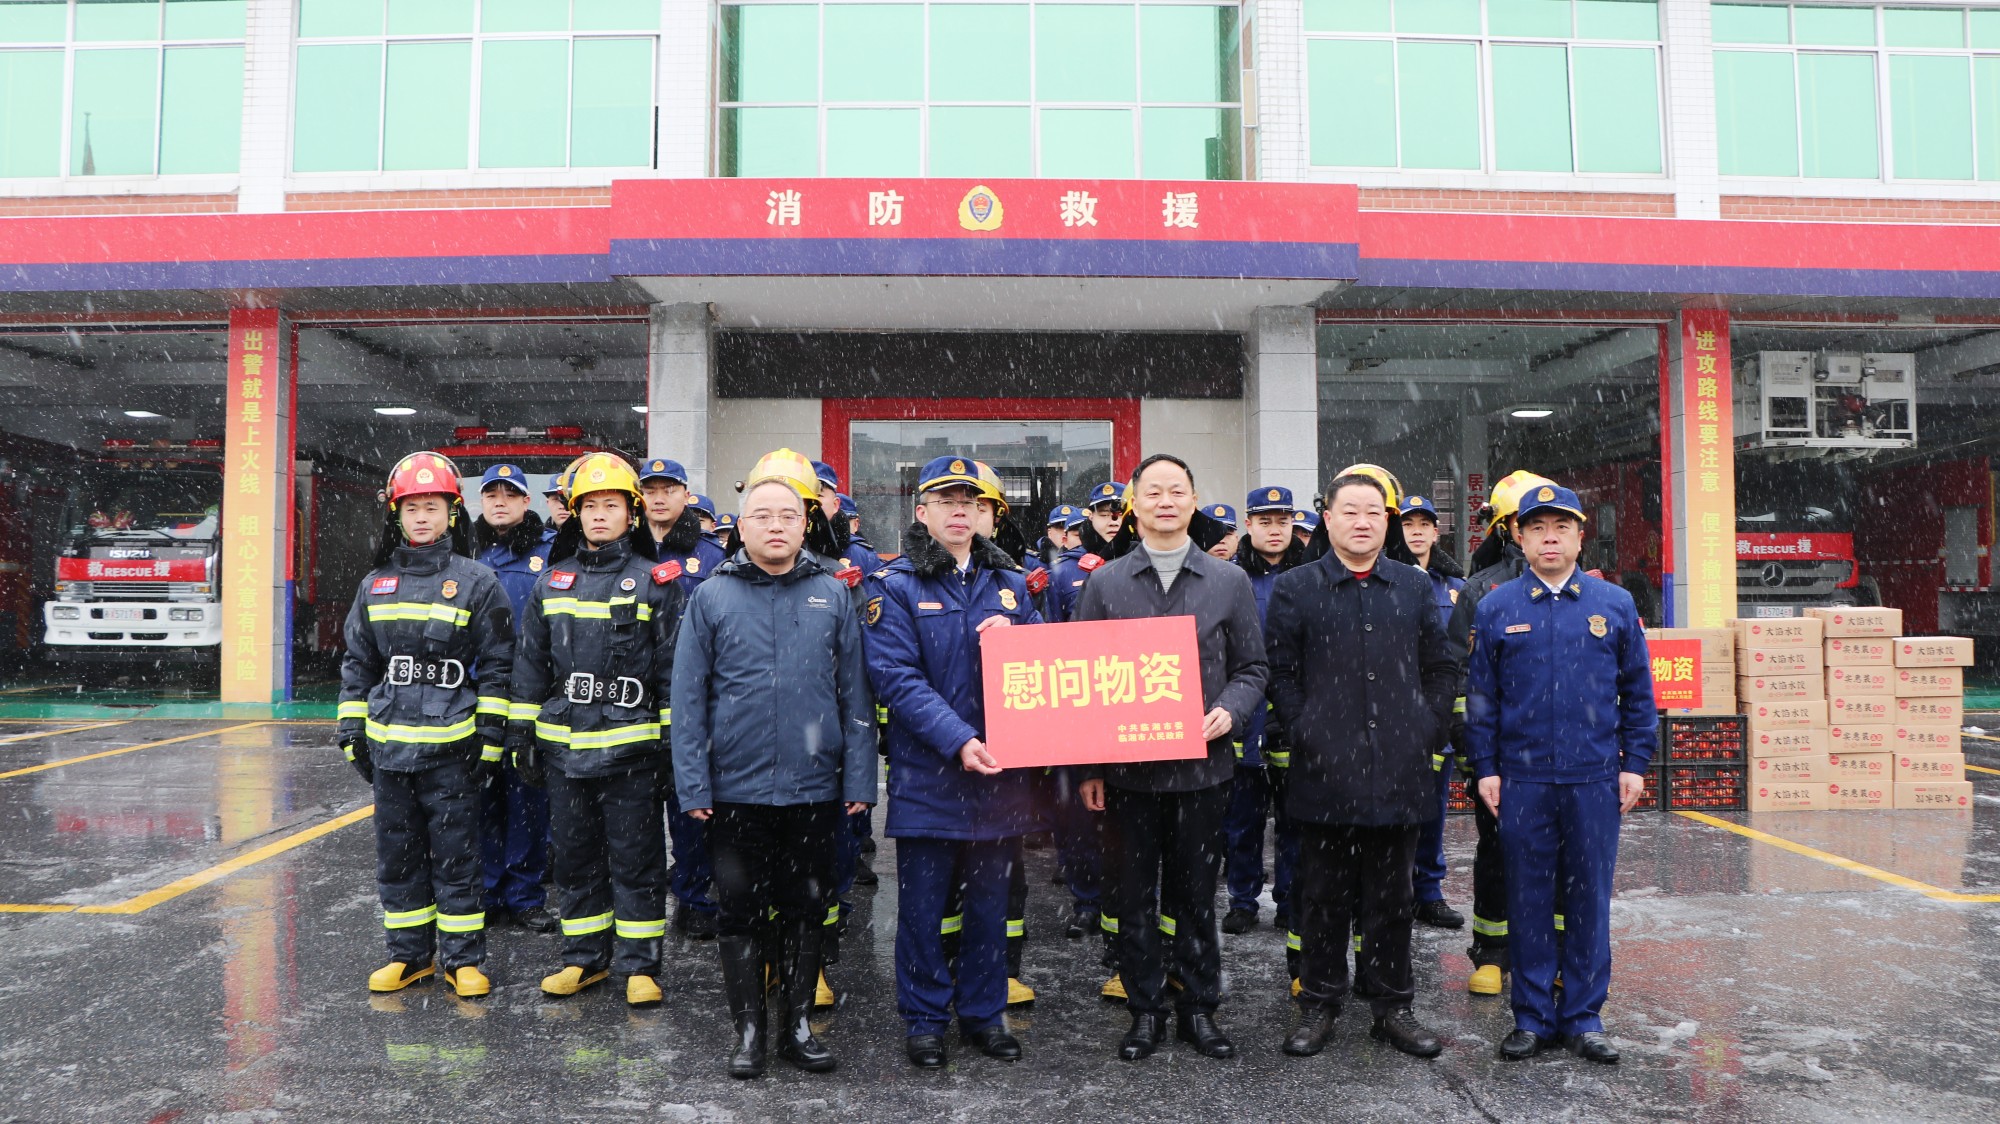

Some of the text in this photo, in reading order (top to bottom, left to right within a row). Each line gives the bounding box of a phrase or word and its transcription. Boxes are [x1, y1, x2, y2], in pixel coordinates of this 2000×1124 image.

[1696, 331, 1720, 492] 进攻路线要注意
[236, 331, 263, 681] 出警就是上火线 粗心大意有风险
[109, 550, 151, 558] ISUZU
[1753, 546, 1796, 554] RESCUE
[105, 567, 152, 577] RESCUE
[1002, 652, 1183, 710] 慰问物资
[1118, 721, 1184, 733] 中共临湘市委
[1118, 731, 1184, 743] 临湘市人民政府
